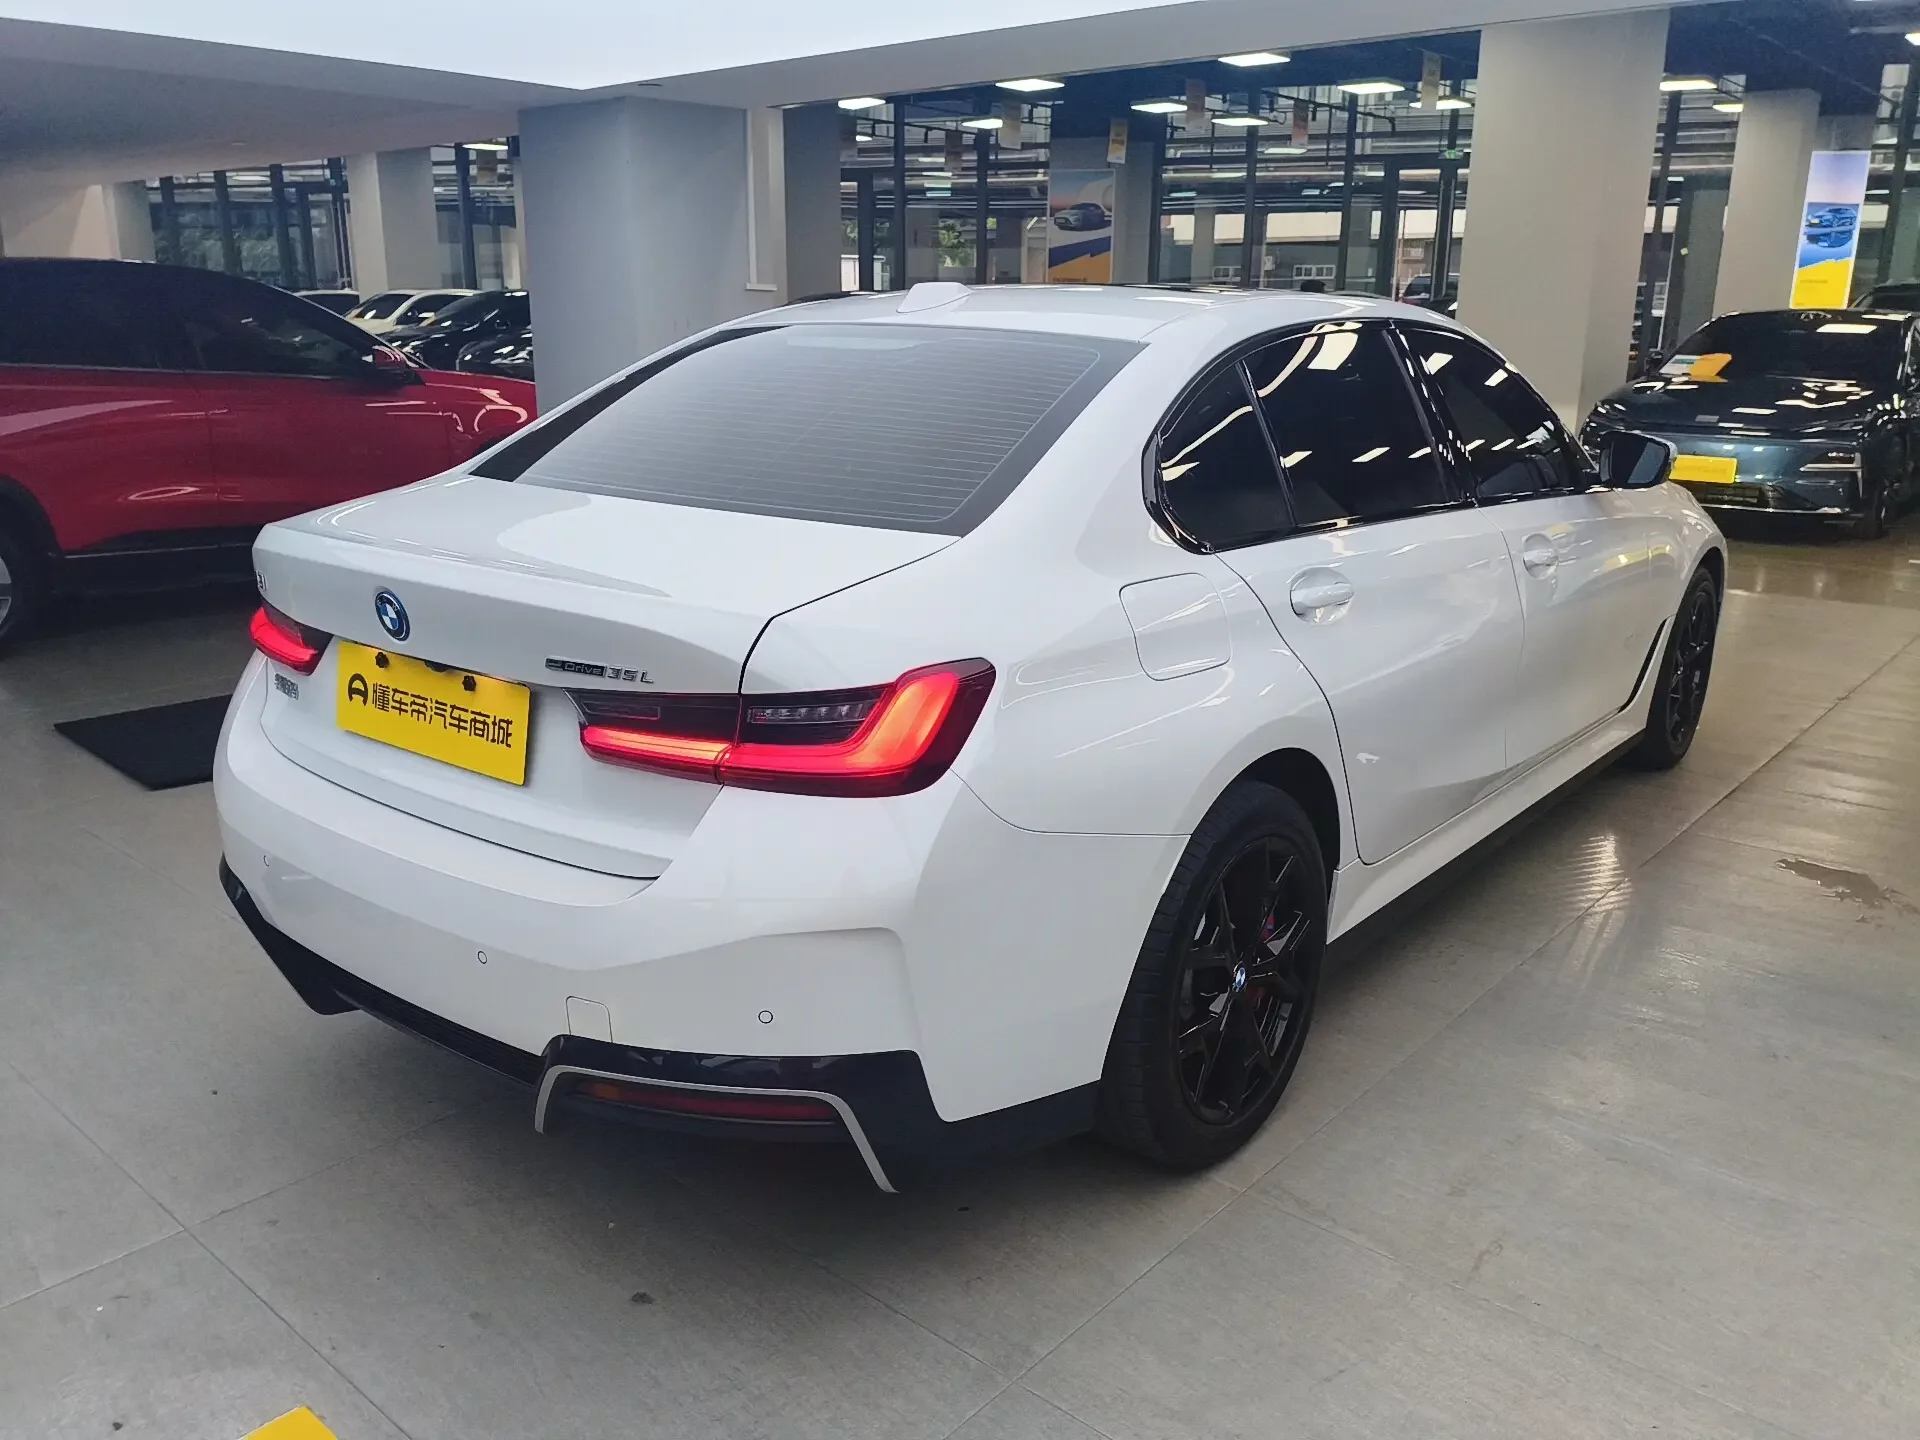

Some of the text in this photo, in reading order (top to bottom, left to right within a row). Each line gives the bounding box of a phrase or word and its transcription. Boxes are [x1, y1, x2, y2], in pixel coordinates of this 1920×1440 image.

[372, 682, 513, 748] 懂车帝汽车商城
